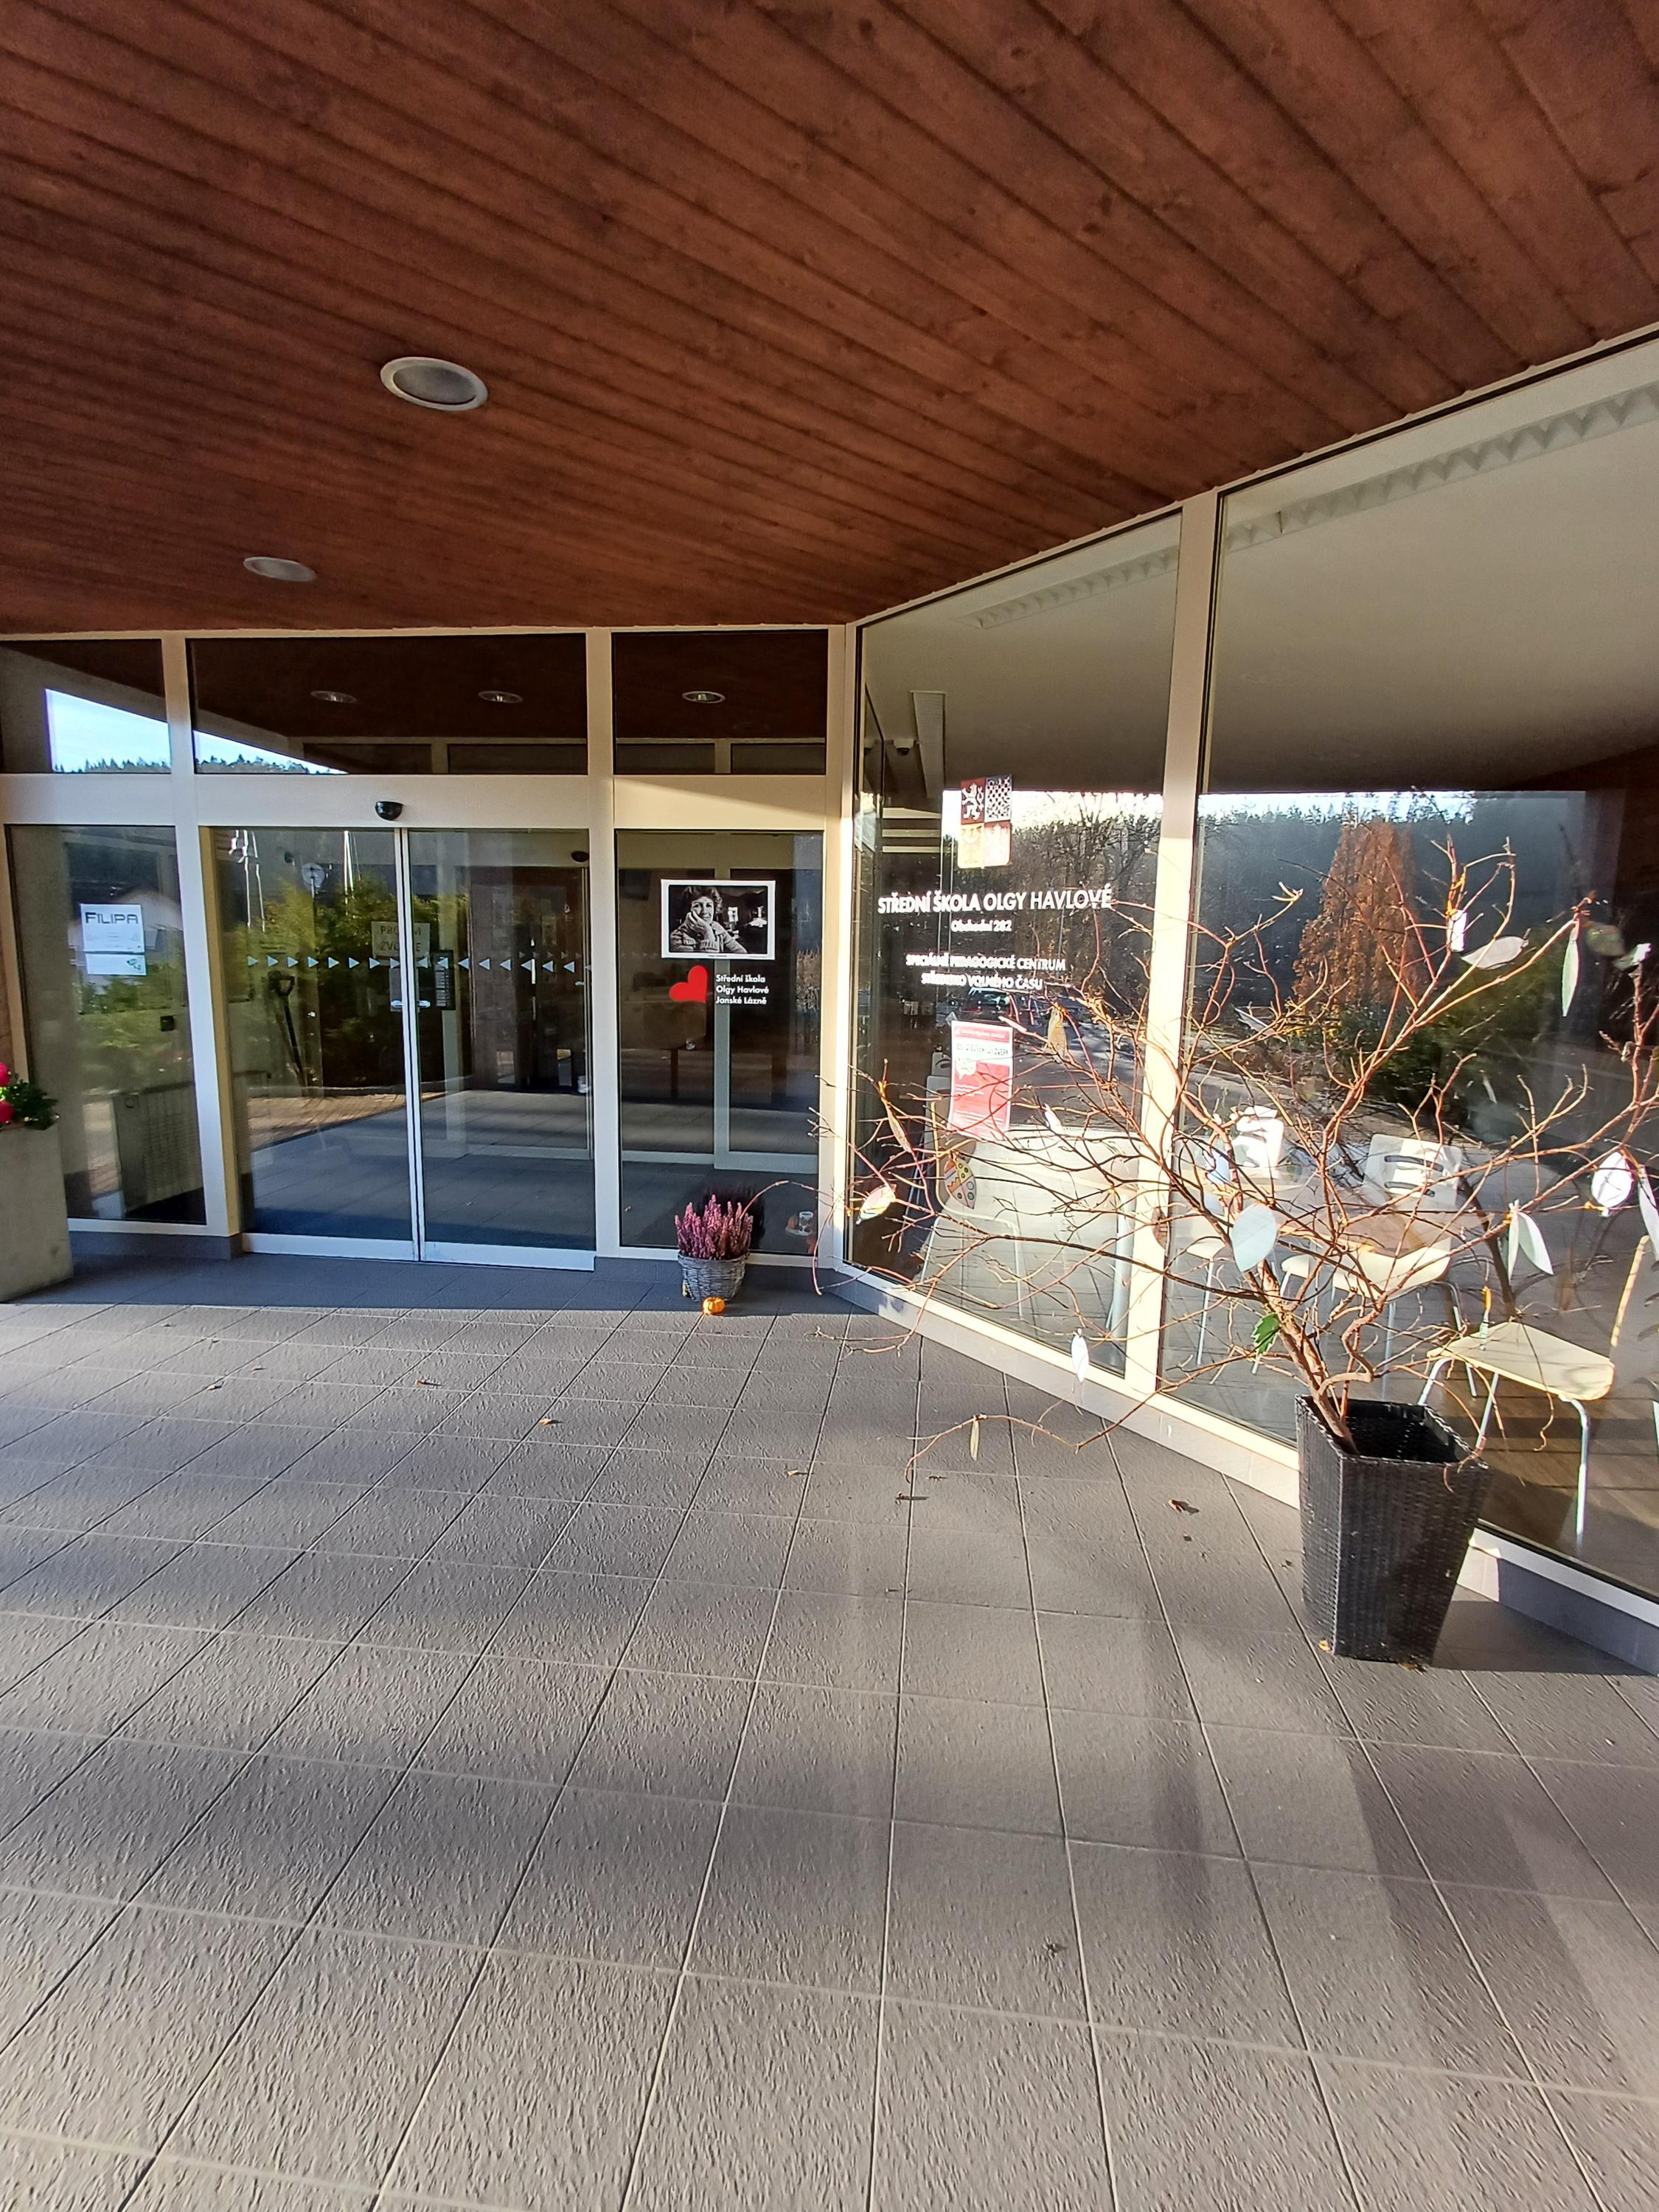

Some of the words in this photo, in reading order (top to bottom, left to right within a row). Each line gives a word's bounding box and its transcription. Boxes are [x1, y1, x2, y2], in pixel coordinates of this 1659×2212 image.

[877, 891, 931, 914] STŘEDNÍ
[933, 889, 981, 912] ŠKOLA
[983, 891, 1027, 911] OLGY
[1030, 883, 1112, 910] HAVLOVÉ
[85, 912, 139, 924] FILIPA
[380, 925, 421, 936] PROM
[380, 941, 421, 952] ZVOE
[1016, 958, 1066, 971] CENTRUM
[716, 974, 743, 982] Střední
[745, 974, 765, 983] škola
[1015, 974, 1043, 990] ČASU
[716, 984, 735, 995] Olgy
[737, 985, 769, 994] Havlové
[716, 995, 742, 1004] Janské
[744, 996, 767, 1005] Lázně
